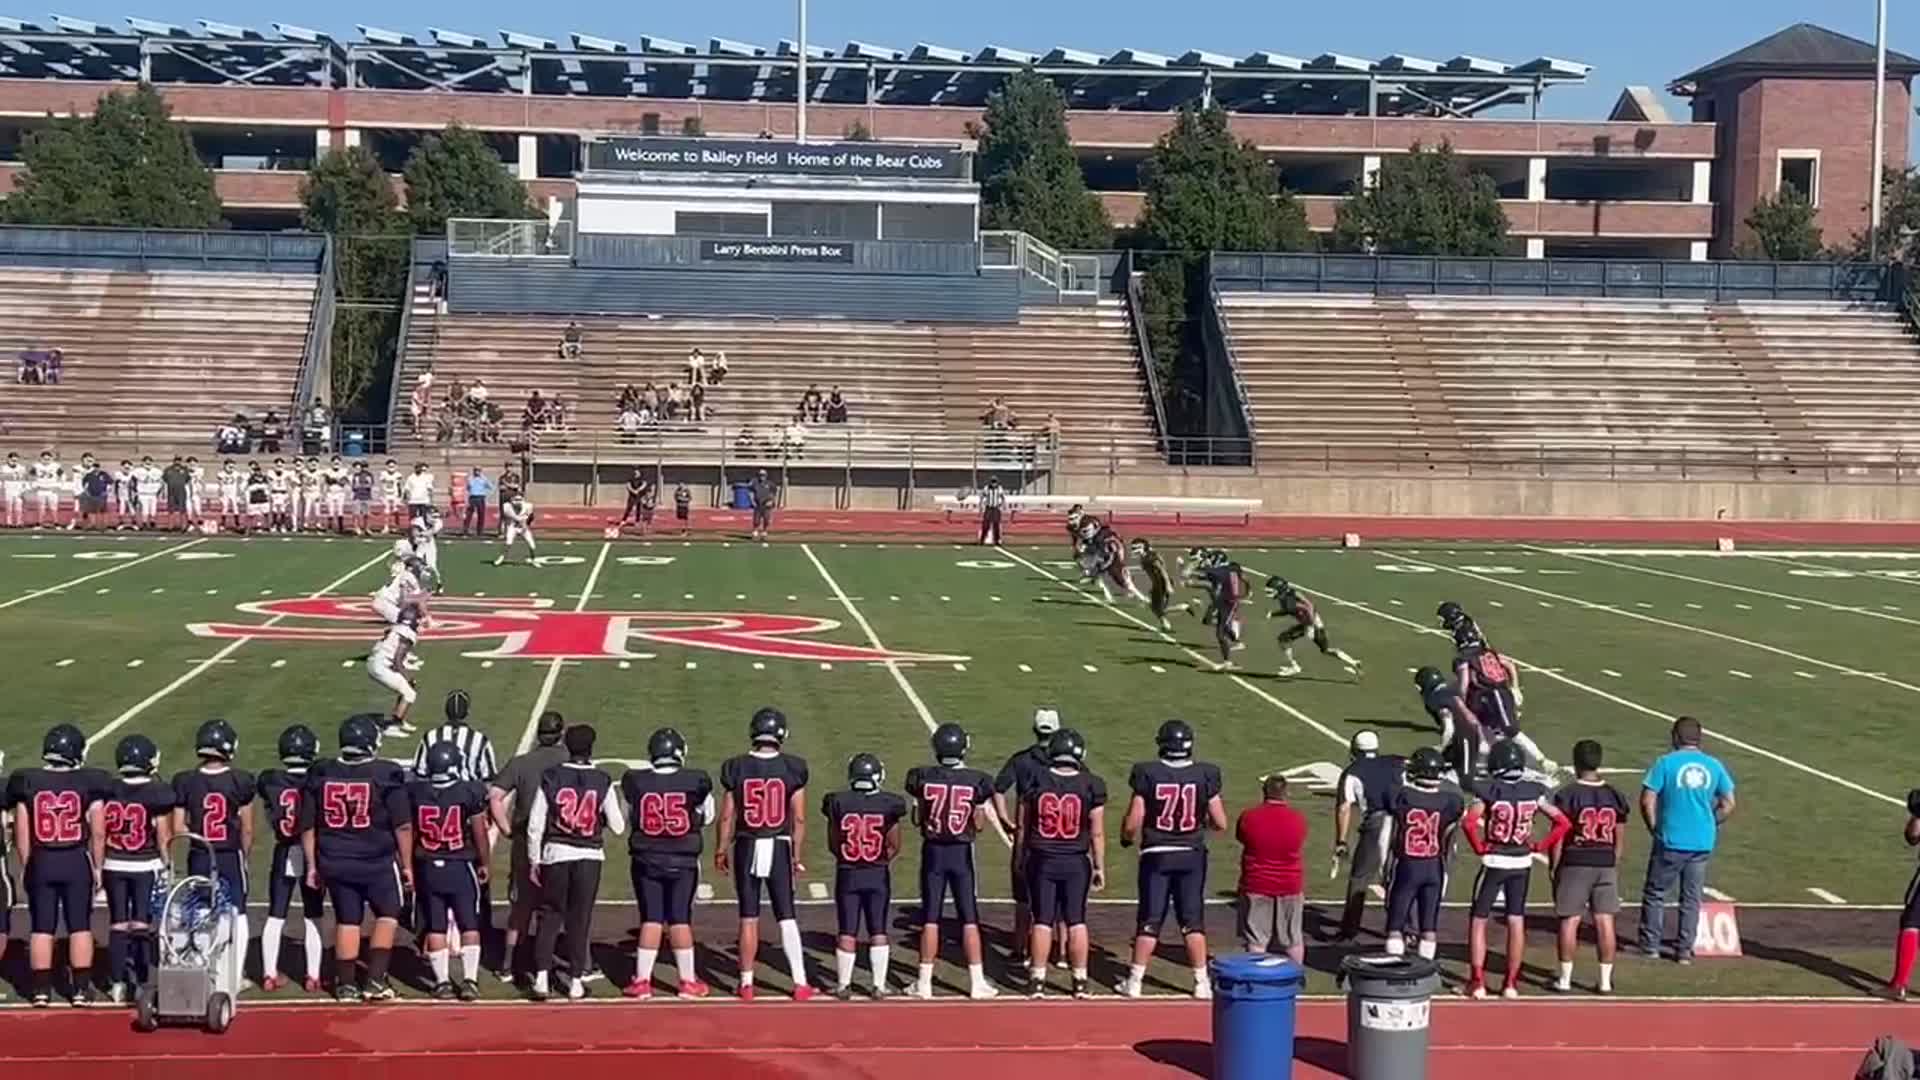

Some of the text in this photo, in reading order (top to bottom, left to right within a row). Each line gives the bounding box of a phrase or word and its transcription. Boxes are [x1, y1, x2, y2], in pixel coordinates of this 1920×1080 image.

[614, 148, 778, 166] Welcome to Bailey Field
[787, 152, 943, 168] Home of the Bear Cubs
[713, 243, 742, 257] Larry
[790, 244, 819, 256] Press
[821, 245, 843, 256] Box
[33, 790, 82, 842] 62
[104, 801, 148, 851] 23
[203, 792, 228, 842] 2
[323, 781, 371, 828] 57
[639, 791, 692, 837] 65
[743, 778, 786, 828] 50
[924, 784, 974, 835] 75
[1155, 784, 1198, 832] 71
[418, 804, 465, 852] 54
[840, 813, 885, 862] 35
[1405, 808, 1441, 857] 21
